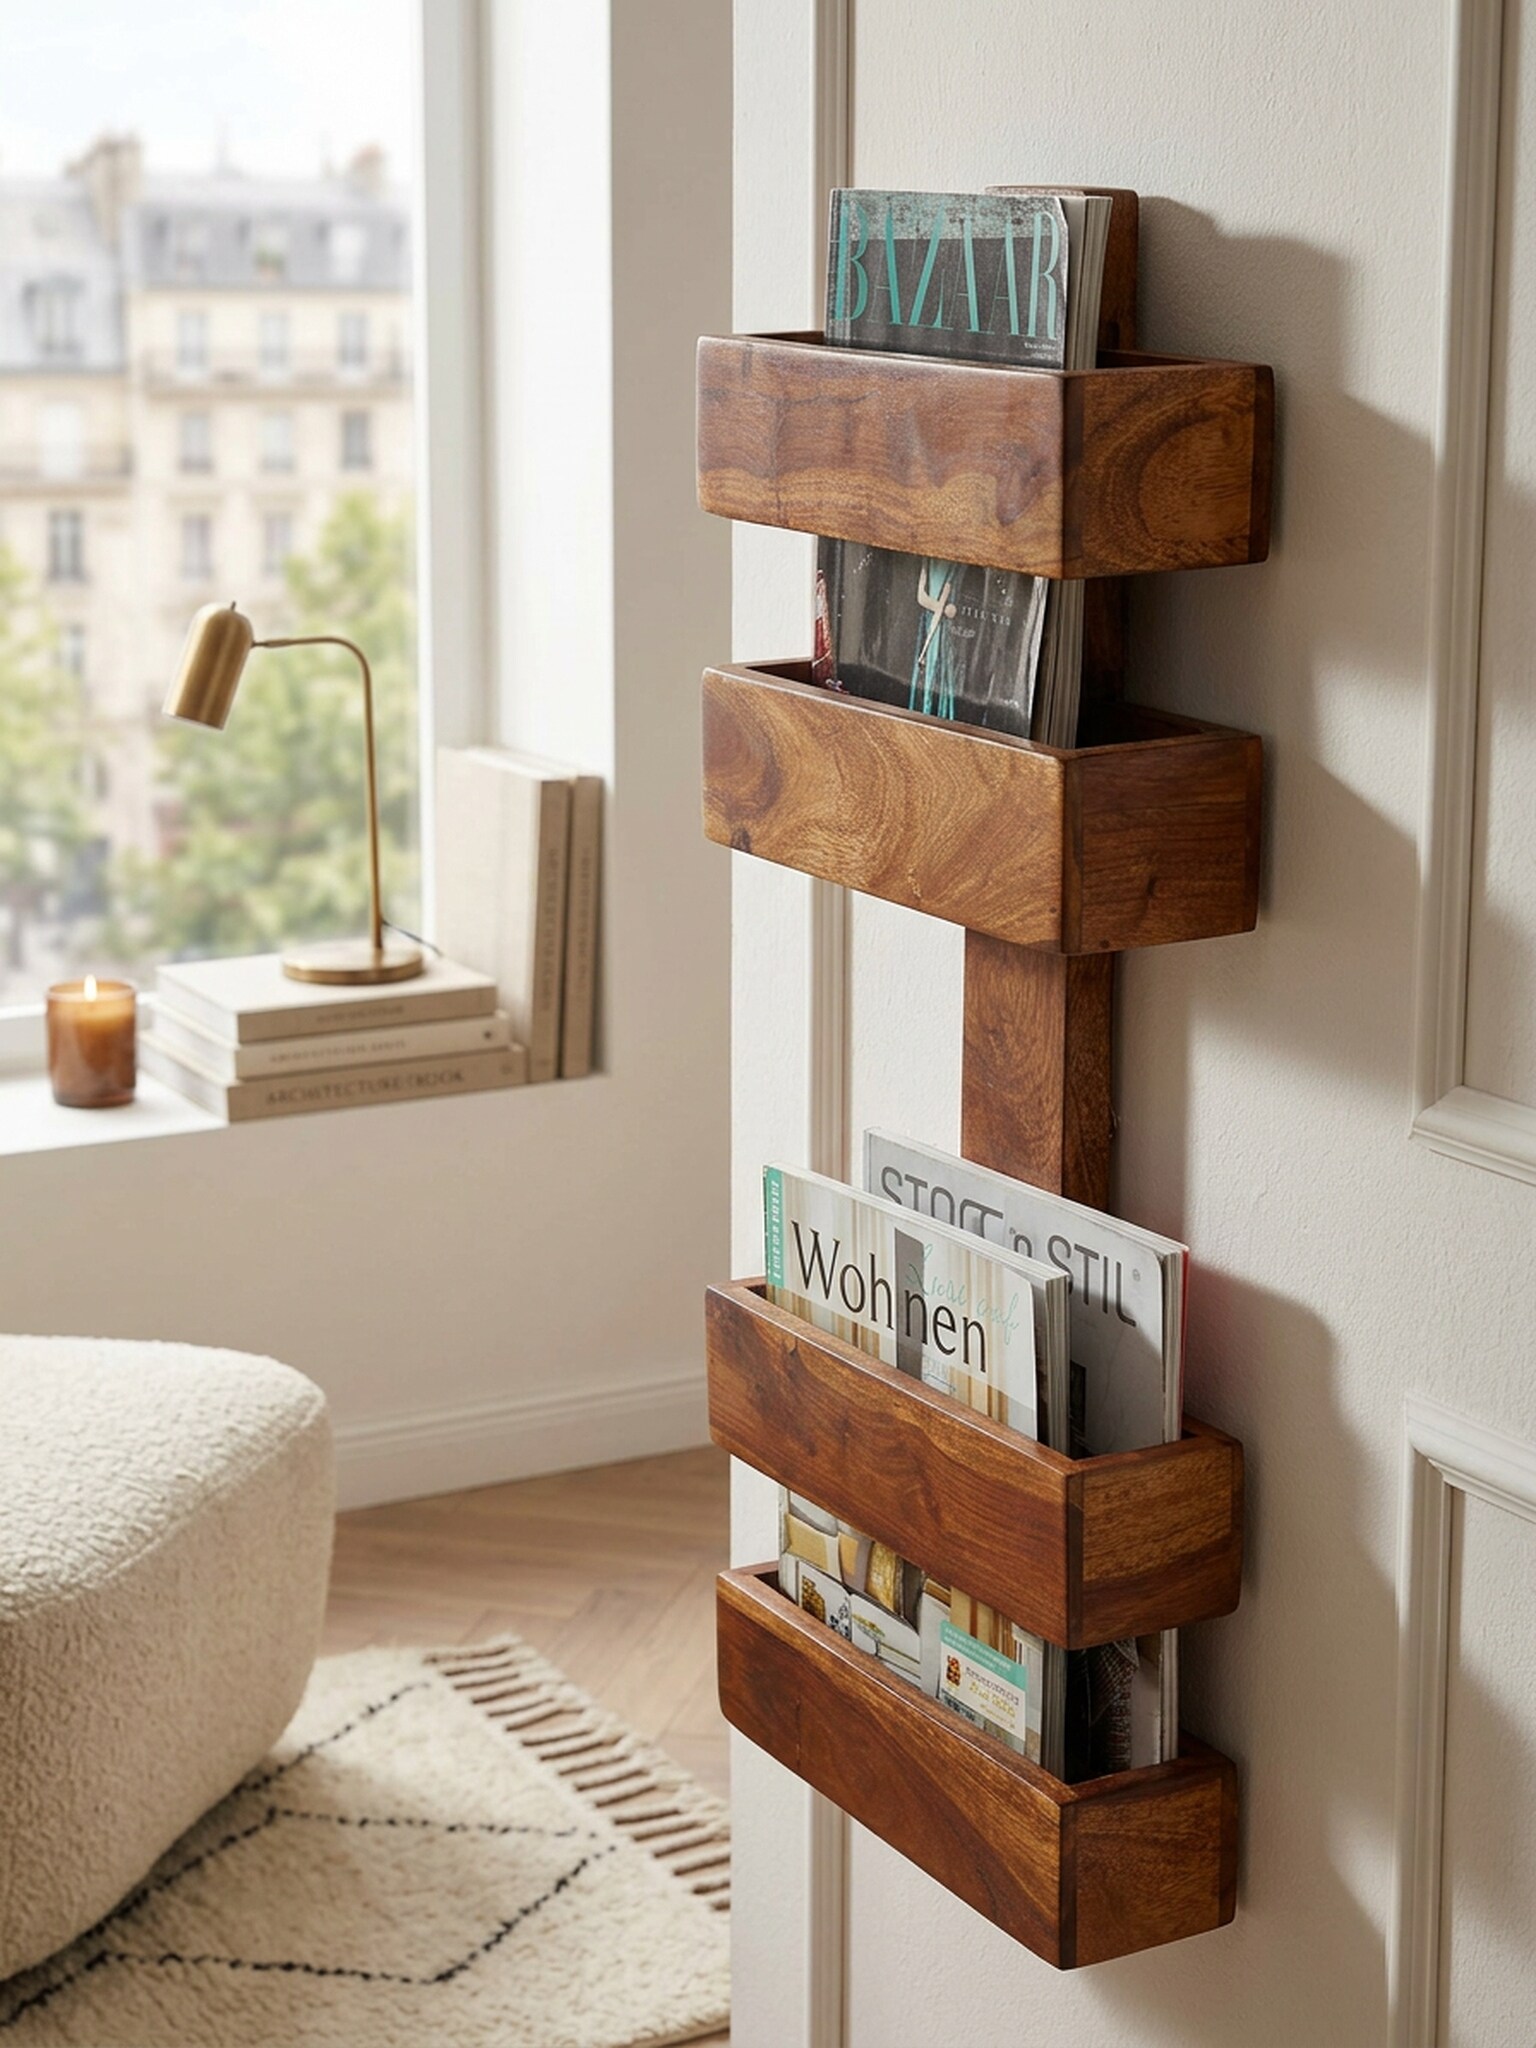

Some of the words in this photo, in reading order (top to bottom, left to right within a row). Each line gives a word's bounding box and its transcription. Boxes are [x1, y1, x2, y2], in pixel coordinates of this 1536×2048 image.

[834, 198, 1059, 341] BAZAAR
[790, 1220, 987, 1373] Wohnen
[1047, 1235, 1137, 1328] STIL
